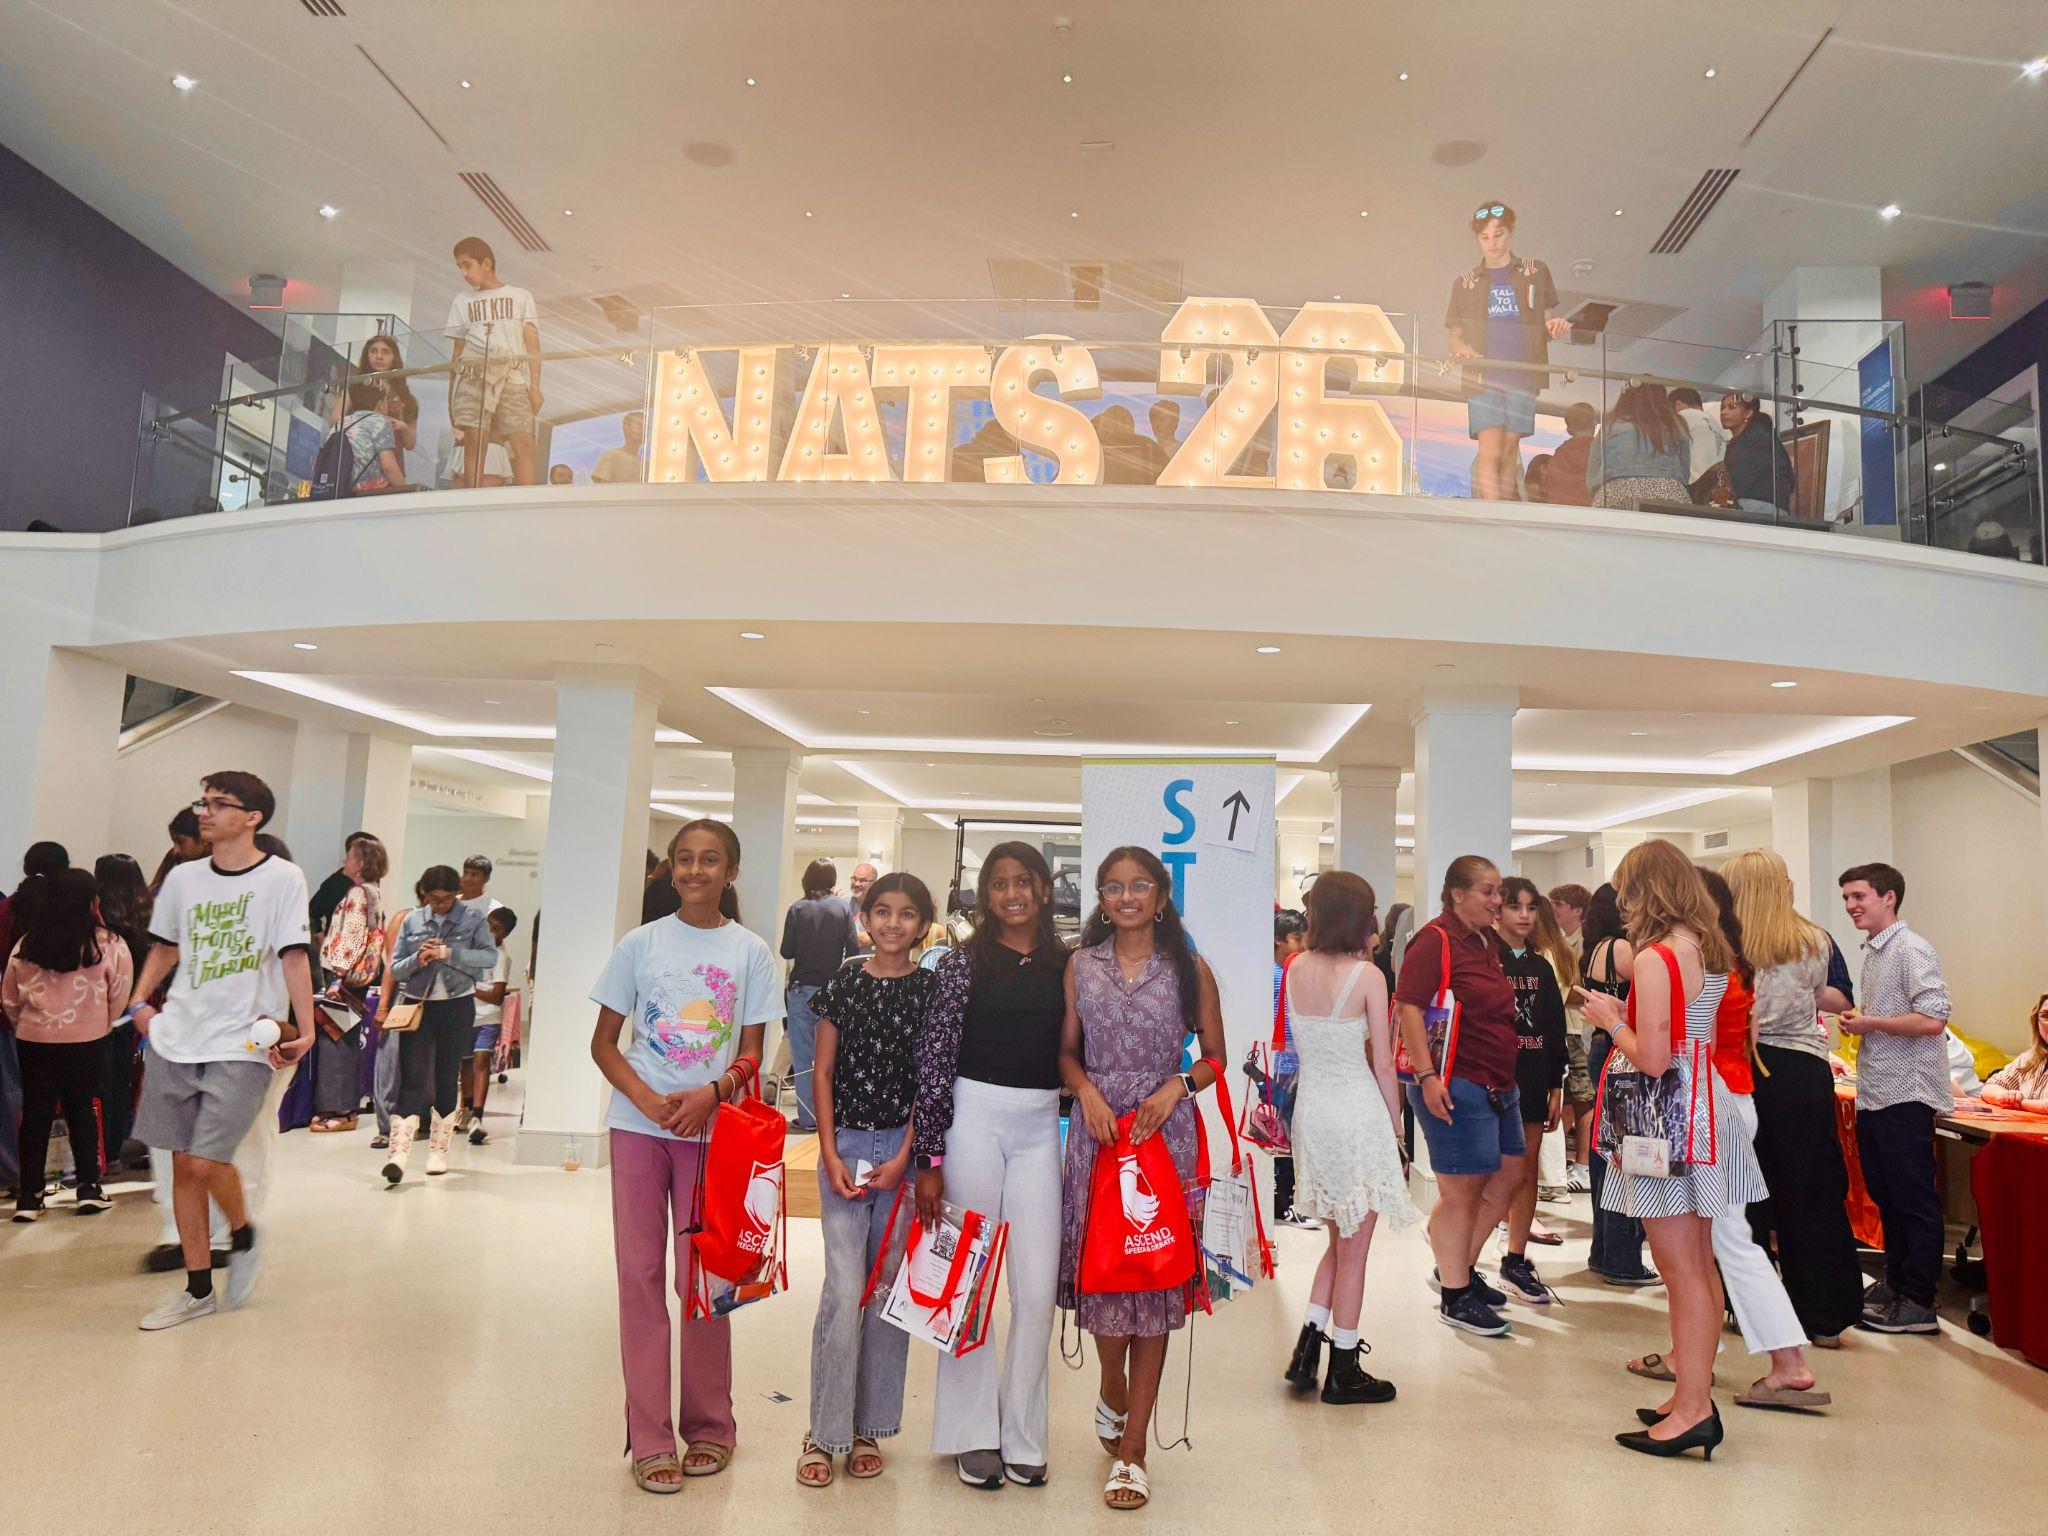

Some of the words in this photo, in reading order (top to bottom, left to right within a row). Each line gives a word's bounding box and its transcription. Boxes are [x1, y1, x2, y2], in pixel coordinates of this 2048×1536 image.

[467, 299, 487, 322] ART
[490, 297, 513, 320] KID
[1496, 297, 1511, 305] TO
[649, 333, 1104, 486] NATS
[1156, 296, 1404, 496] 26
[1124, 1226, 1171, 1249] ASCEND
